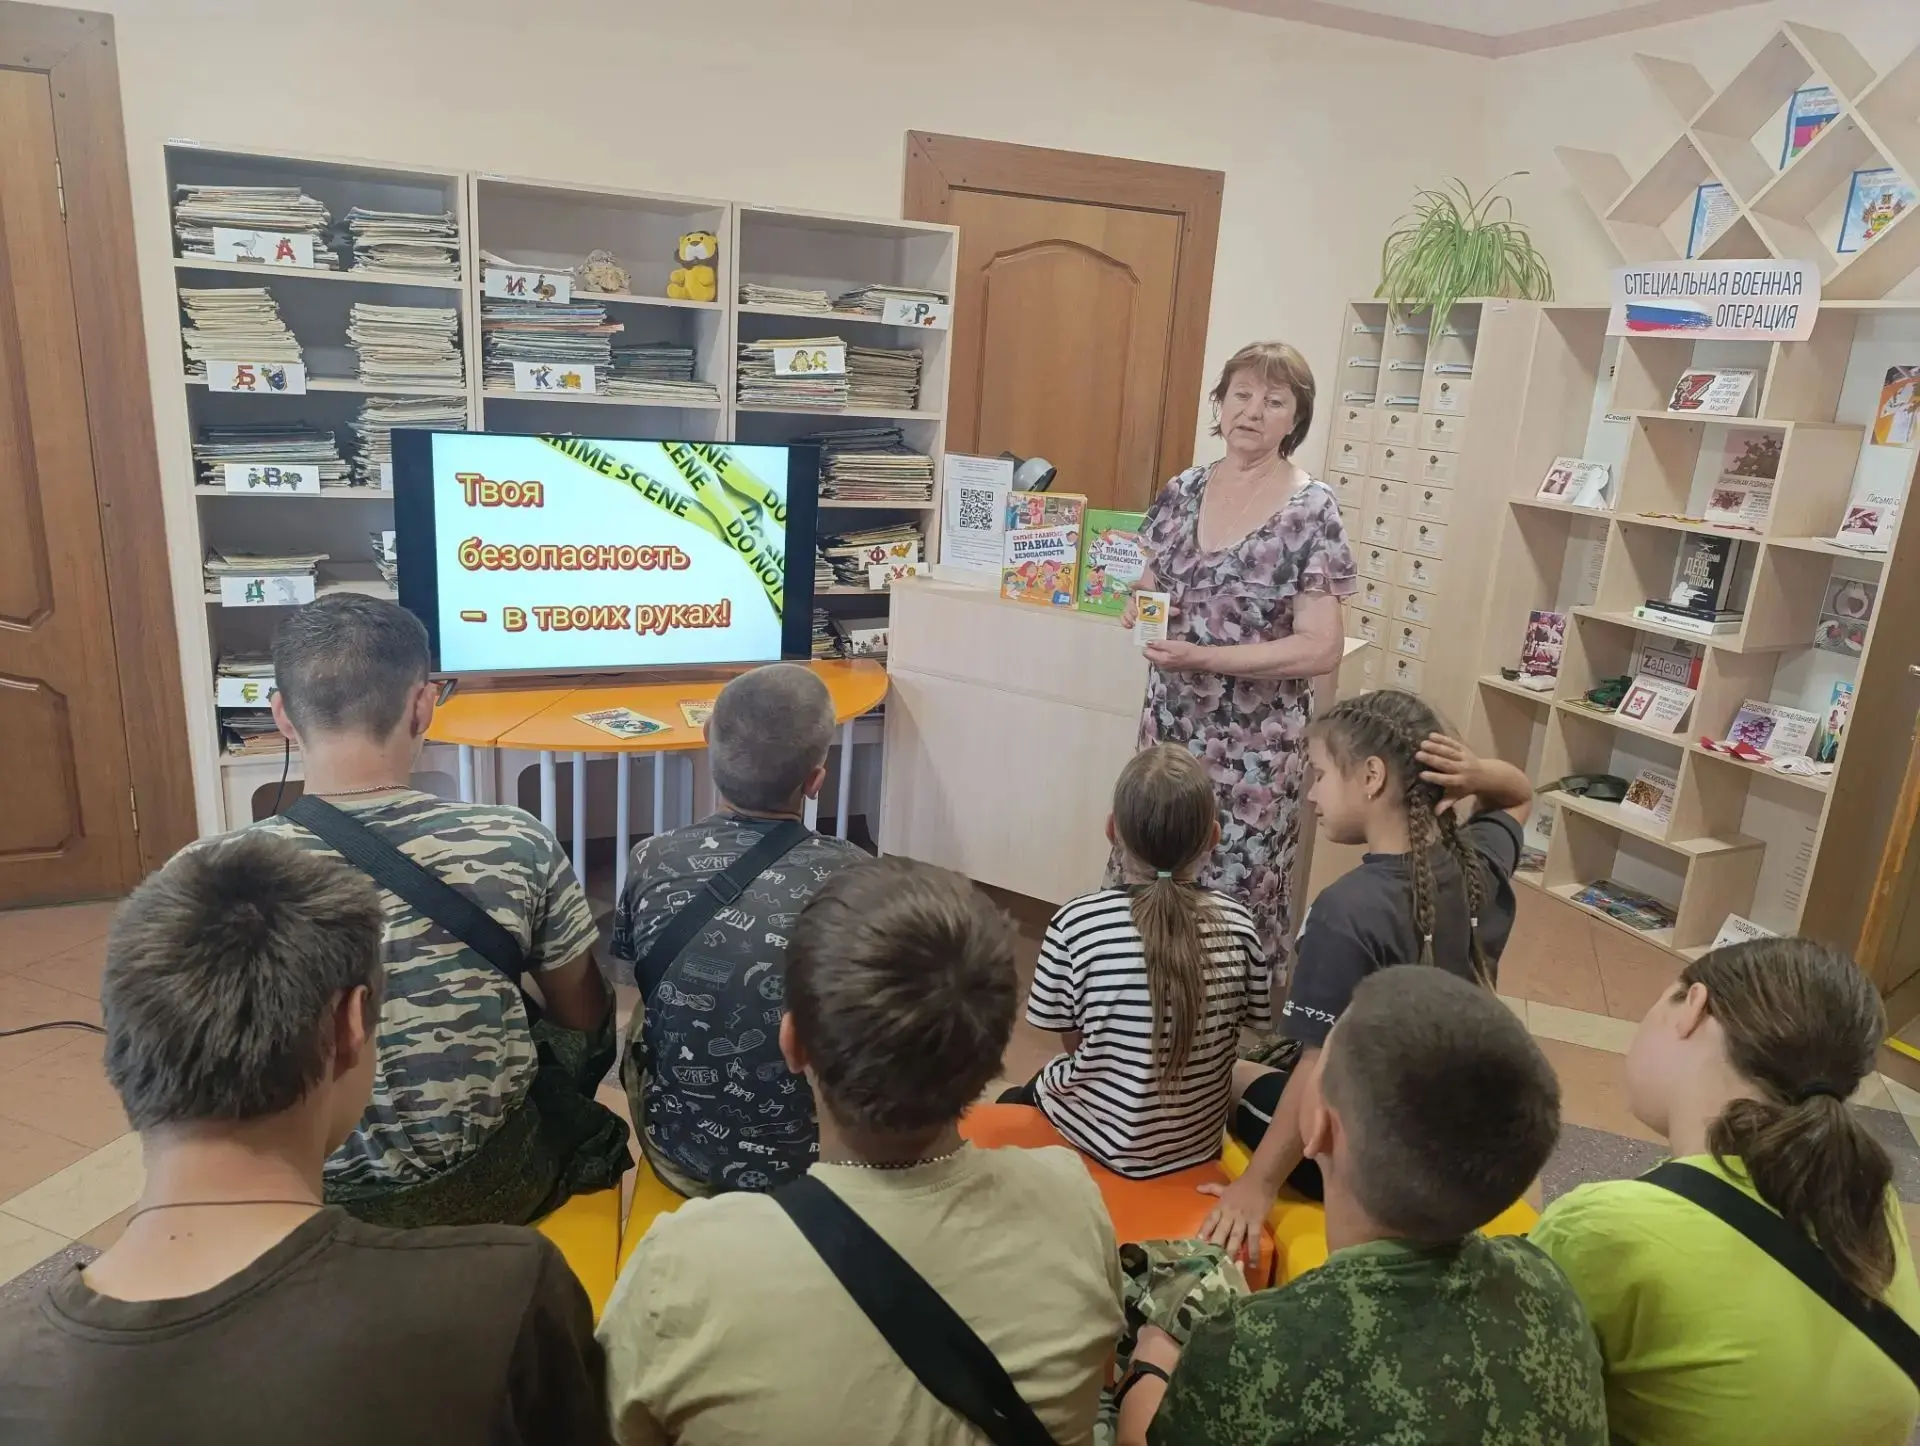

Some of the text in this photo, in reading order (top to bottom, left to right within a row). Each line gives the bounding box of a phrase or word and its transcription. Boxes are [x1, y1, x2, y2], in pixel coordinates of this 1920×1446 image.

[1624, 271, 1802, 298] СПЕЦИАЛЬНАЯ ВОЕННАЯ
[1715, 304, 1799, 331] ОПЕРАЦИЯ
[456, 472, 544, 507] Твоя
[615, 463, 692, 518] SCENE
[726, 518, 756, 553] DO
[1013, 538, 1064, 551] ПРАВИЛА
[458, 536, 690, 571] безопасность
[1014, 549, 1065, 560] БЕЗОПАСНОСТИ
[1105, 547, 1138, 558] ПРАВИЛА
[1684, 557, 1710, 577] ДЕНЬ
[1689, 575, 1714, 589] ОТПУСКА
[503, 606, 527, 631] в
[533, 604, 629, 631] твоих
[636, 598, 731, 636] руках!
